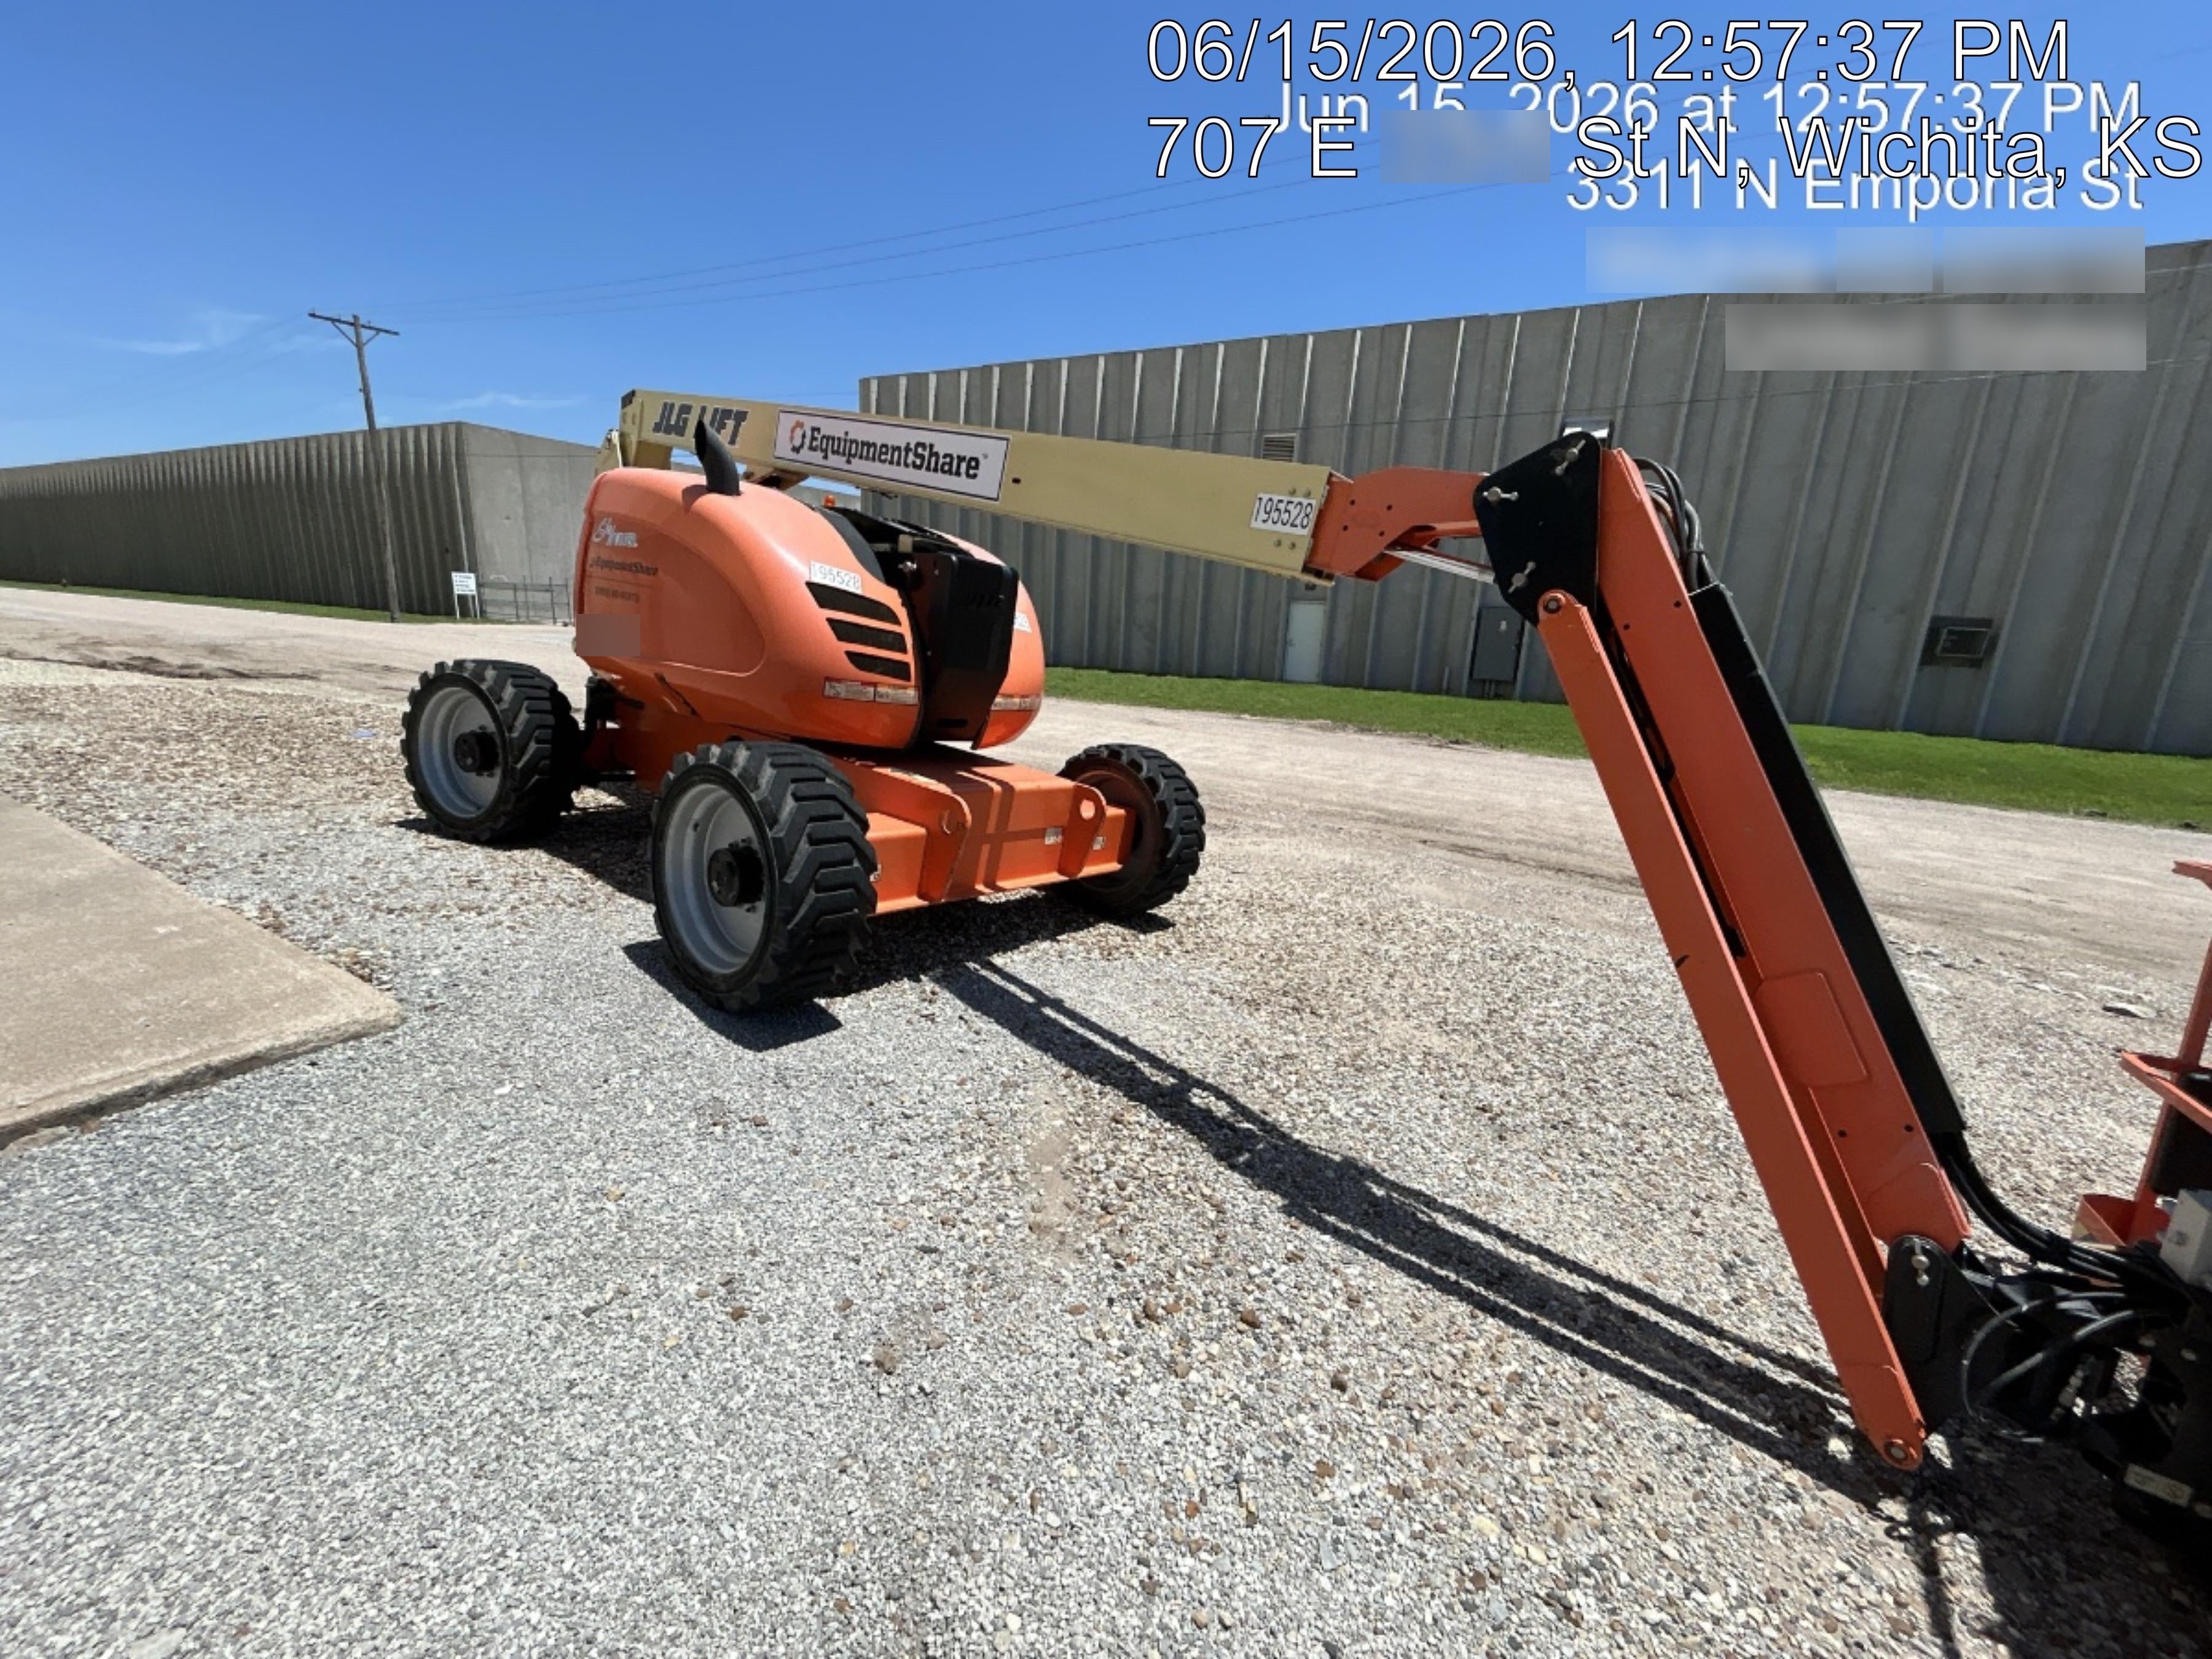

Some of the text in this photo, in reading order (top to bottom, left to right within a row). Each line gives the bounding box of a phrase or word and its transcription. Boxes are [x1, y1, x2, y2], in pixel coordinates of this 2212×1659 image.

[652, 402, 693, 437] JLG
[807, 426, 981, 480] EquipmentShare
[1254, 497, 1314, 529] 195528
